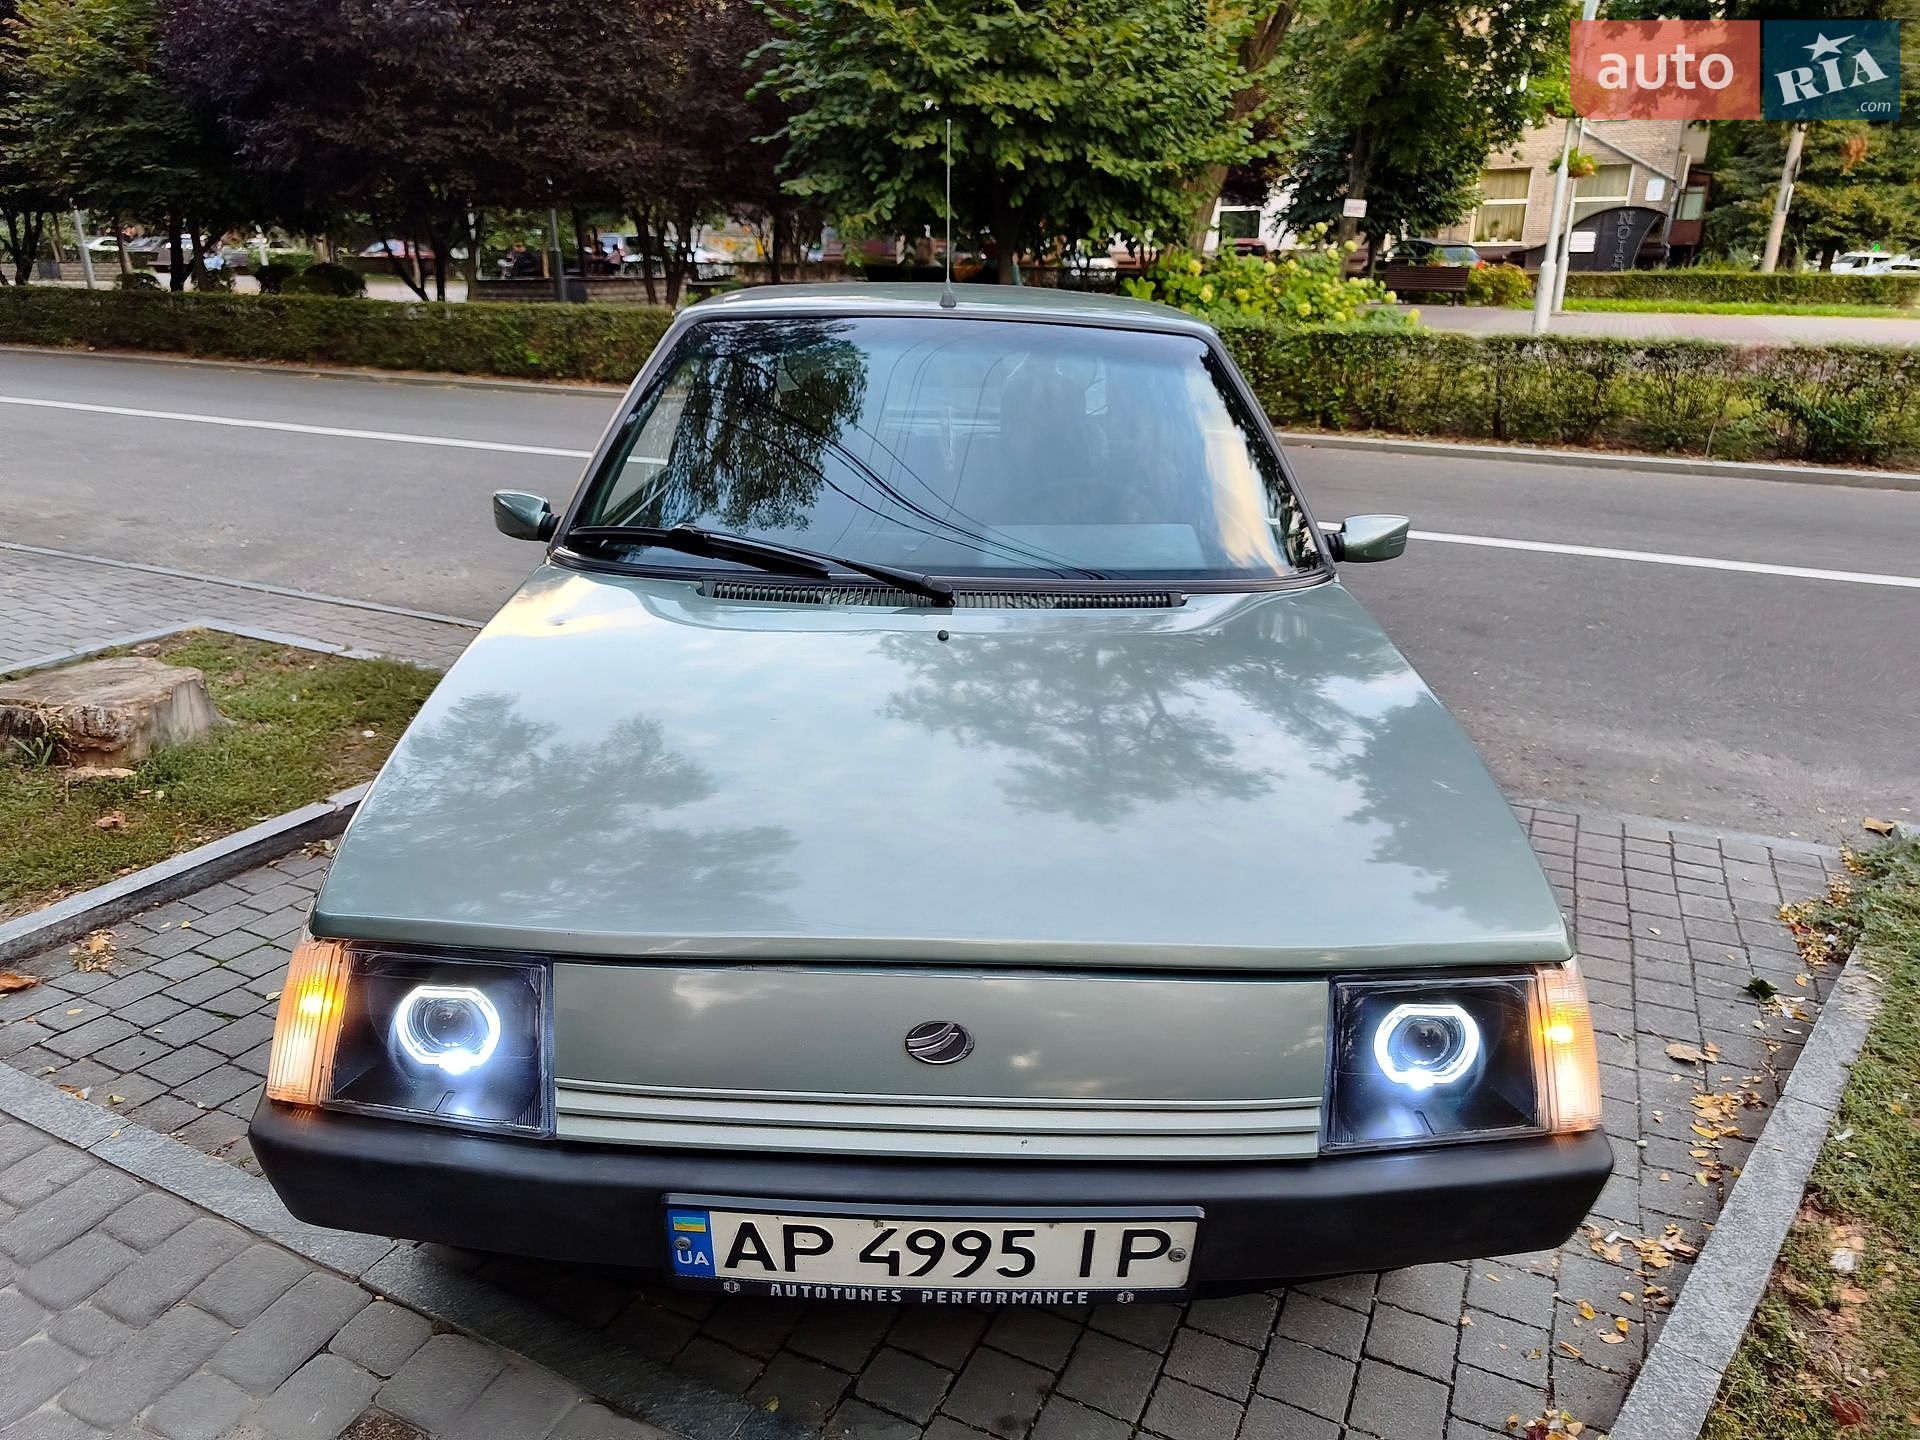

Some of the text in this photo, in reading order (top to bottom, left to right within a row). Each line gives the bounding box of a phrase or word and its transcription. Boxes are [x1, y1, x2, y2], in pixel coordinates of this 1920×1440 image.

[677, 1250, 710, 1266] UA
[724, 1221, 1172, 1278] AP 4995 IP
[770, 1283, 1089, 1305] AUTOTUNES PERFORMANCE
